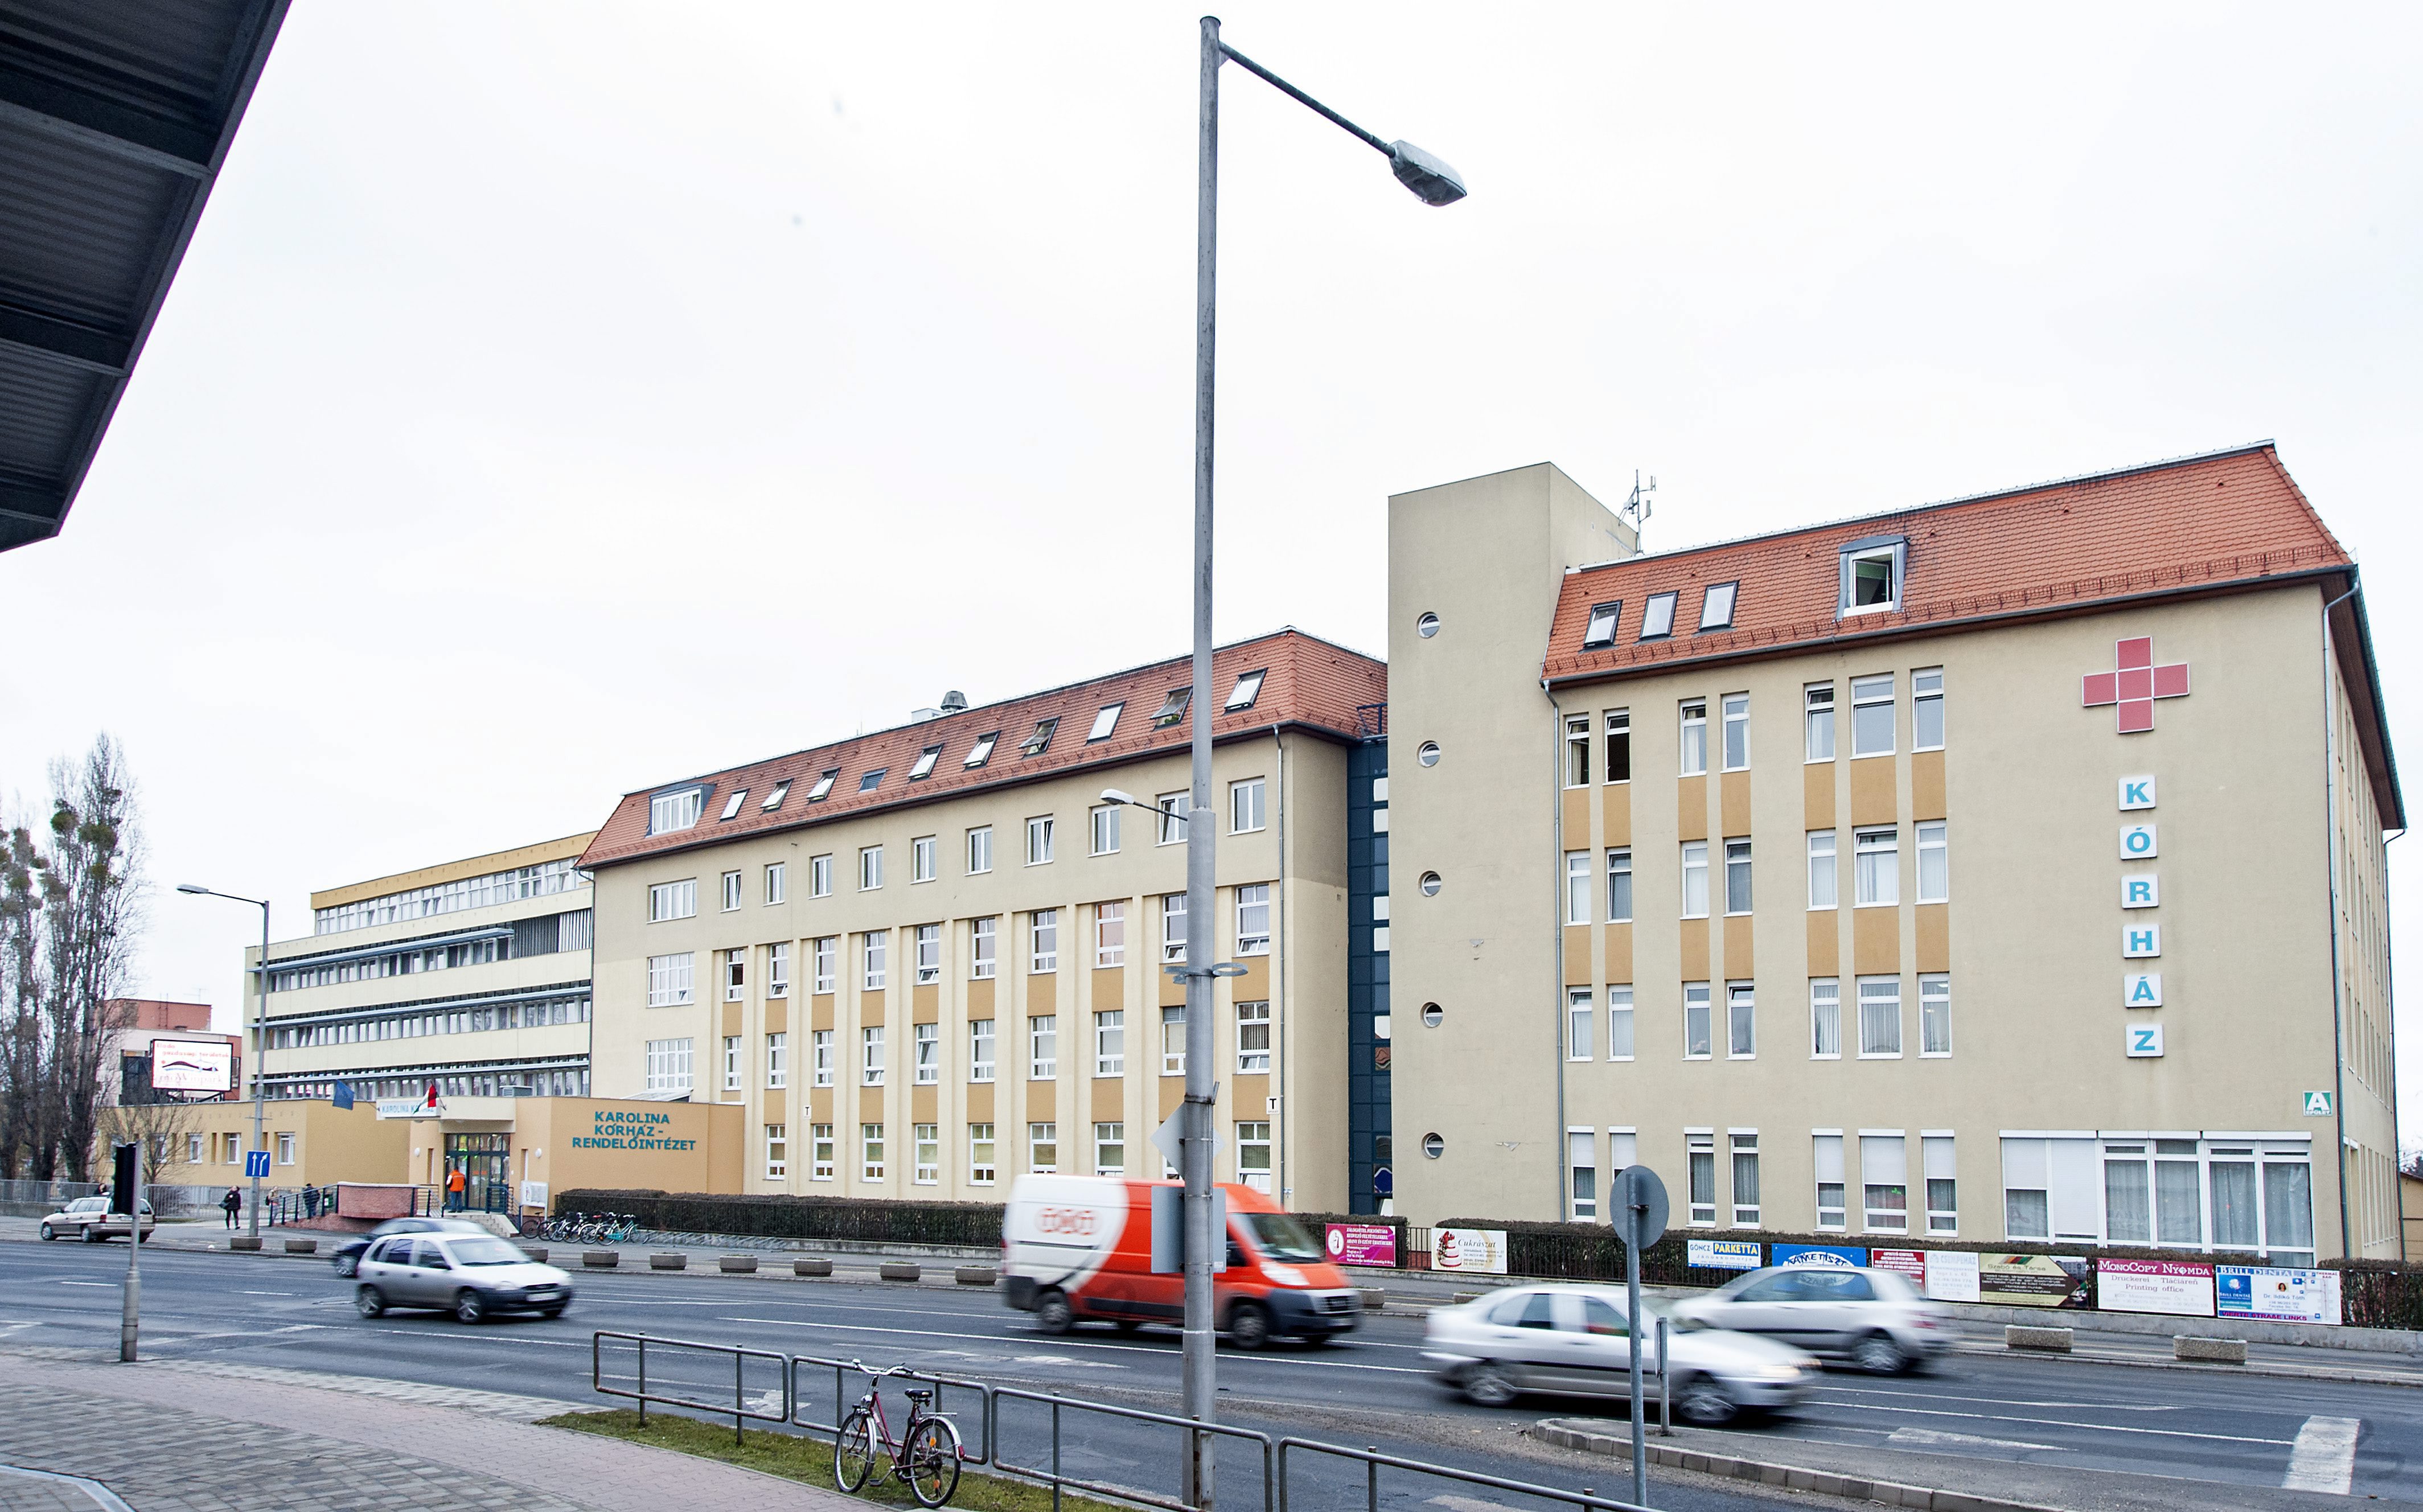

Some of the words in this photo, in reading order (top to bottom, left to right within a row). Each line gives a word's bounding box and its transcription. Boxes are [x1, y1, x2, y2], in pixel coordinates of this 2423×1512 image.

[2125, 782, 2156, 1051] KÓRHÁZ
[1269, 1098, 1277, 1110] T
[2306, 1092, 2330, 1111] A
[594, 1111, 670, 1124] KAROLINA
[804, 1106, 810, 1116] T
[594, 1123, 655, 1137] KÓRHÁZ
[572, 1135, 696, 1151] RENDELŐINTÉZET
[1458, 1239, 1496, 1248] Cukrászat
[1714, 1243, 1758, 1255] PARKETTA
